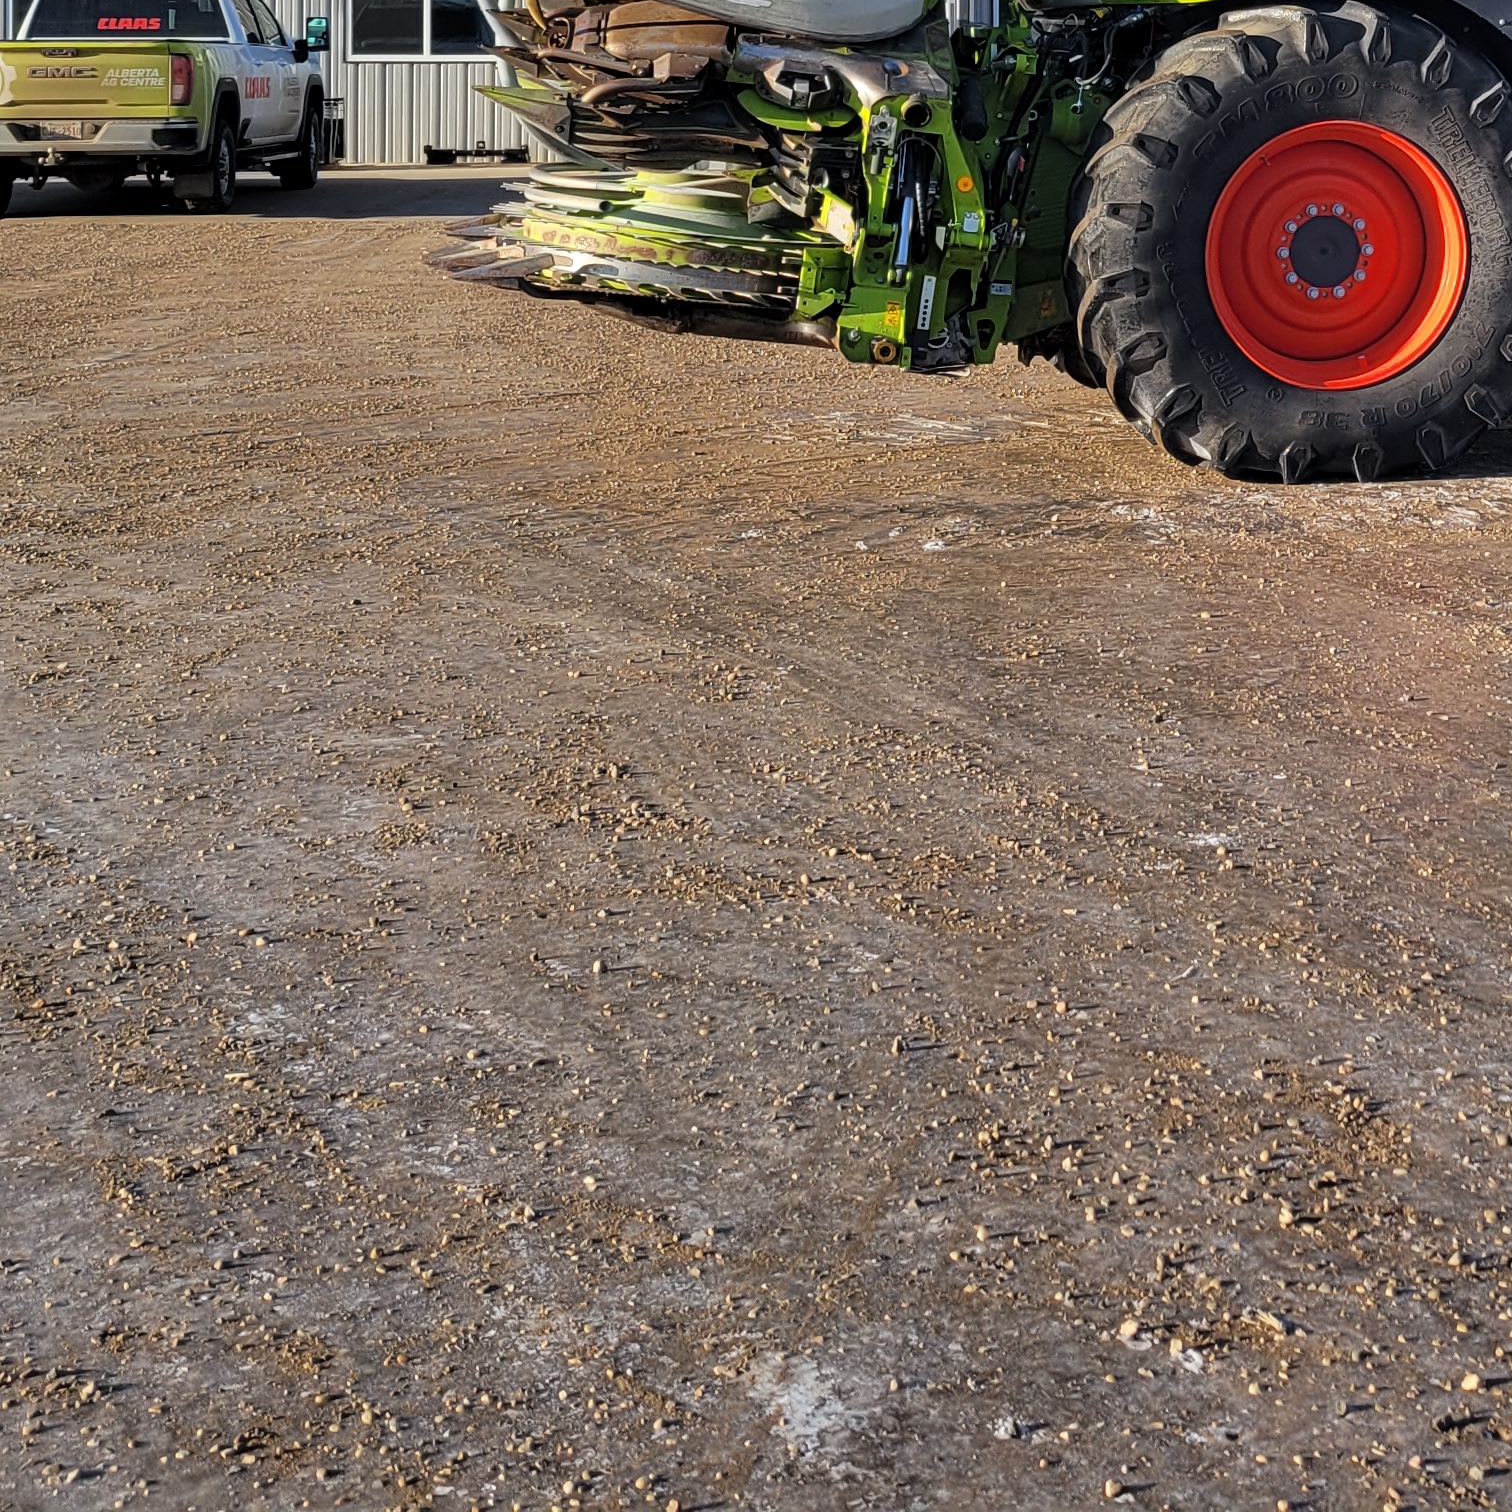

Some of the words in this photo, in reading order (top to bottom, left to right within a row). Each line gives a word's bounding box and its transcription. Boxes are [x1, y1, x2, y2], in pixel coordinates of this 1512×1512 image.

[97, 17, 161, 30] CLAAS
[27, 66, 99, 79] GMC
[106, 68, 160, 78] ALBERTA
[101, 78, 117, 87] AG
[120, 77, 166, 87] CENTRE
[1394, 319, 1496, 419] 710/70
[1298, 409, 1350, 431] 38
[1360, 406, 1388, 428] R
